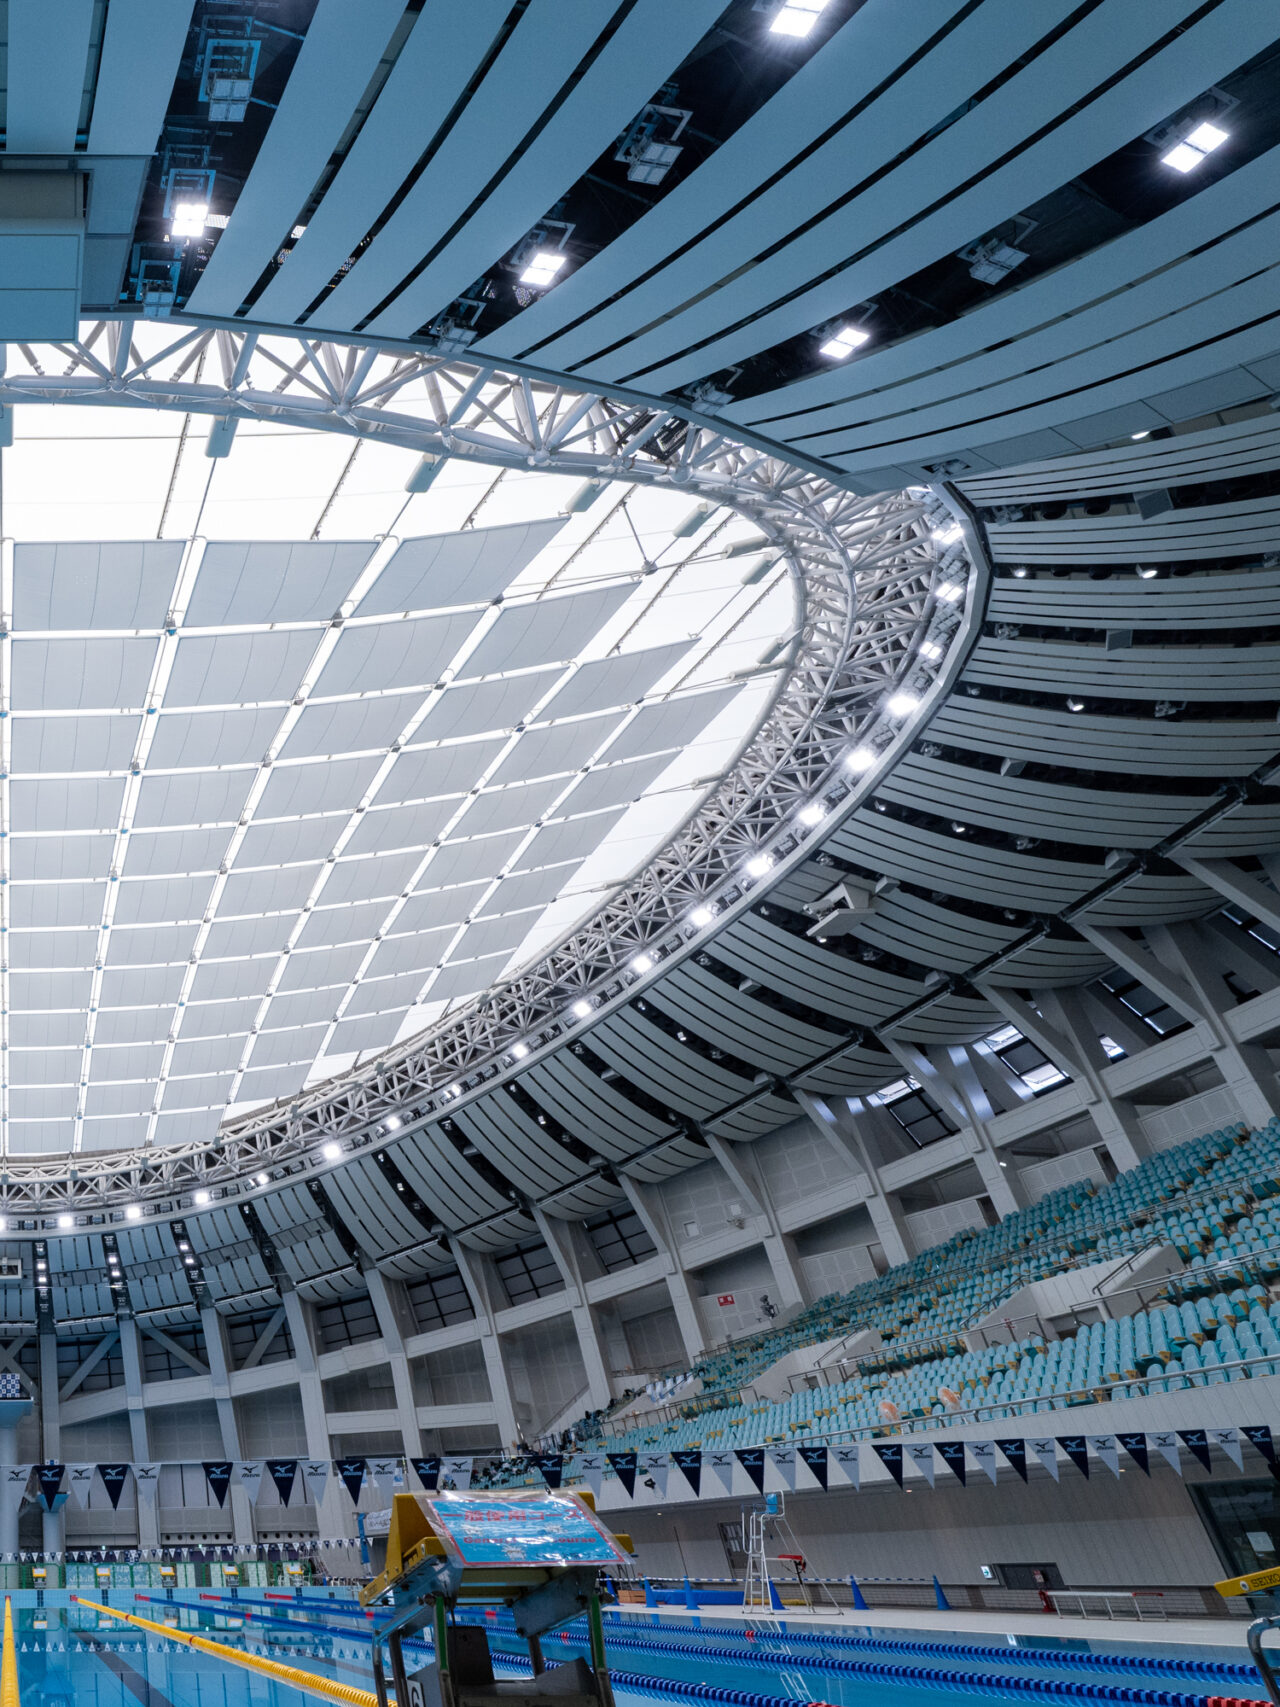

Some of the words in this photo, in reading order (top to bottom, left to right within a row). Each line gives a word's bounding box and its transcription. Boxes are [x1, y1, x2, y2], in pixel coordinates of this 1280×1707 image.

[442, 1509, 583, 1522] 一般使用コース
